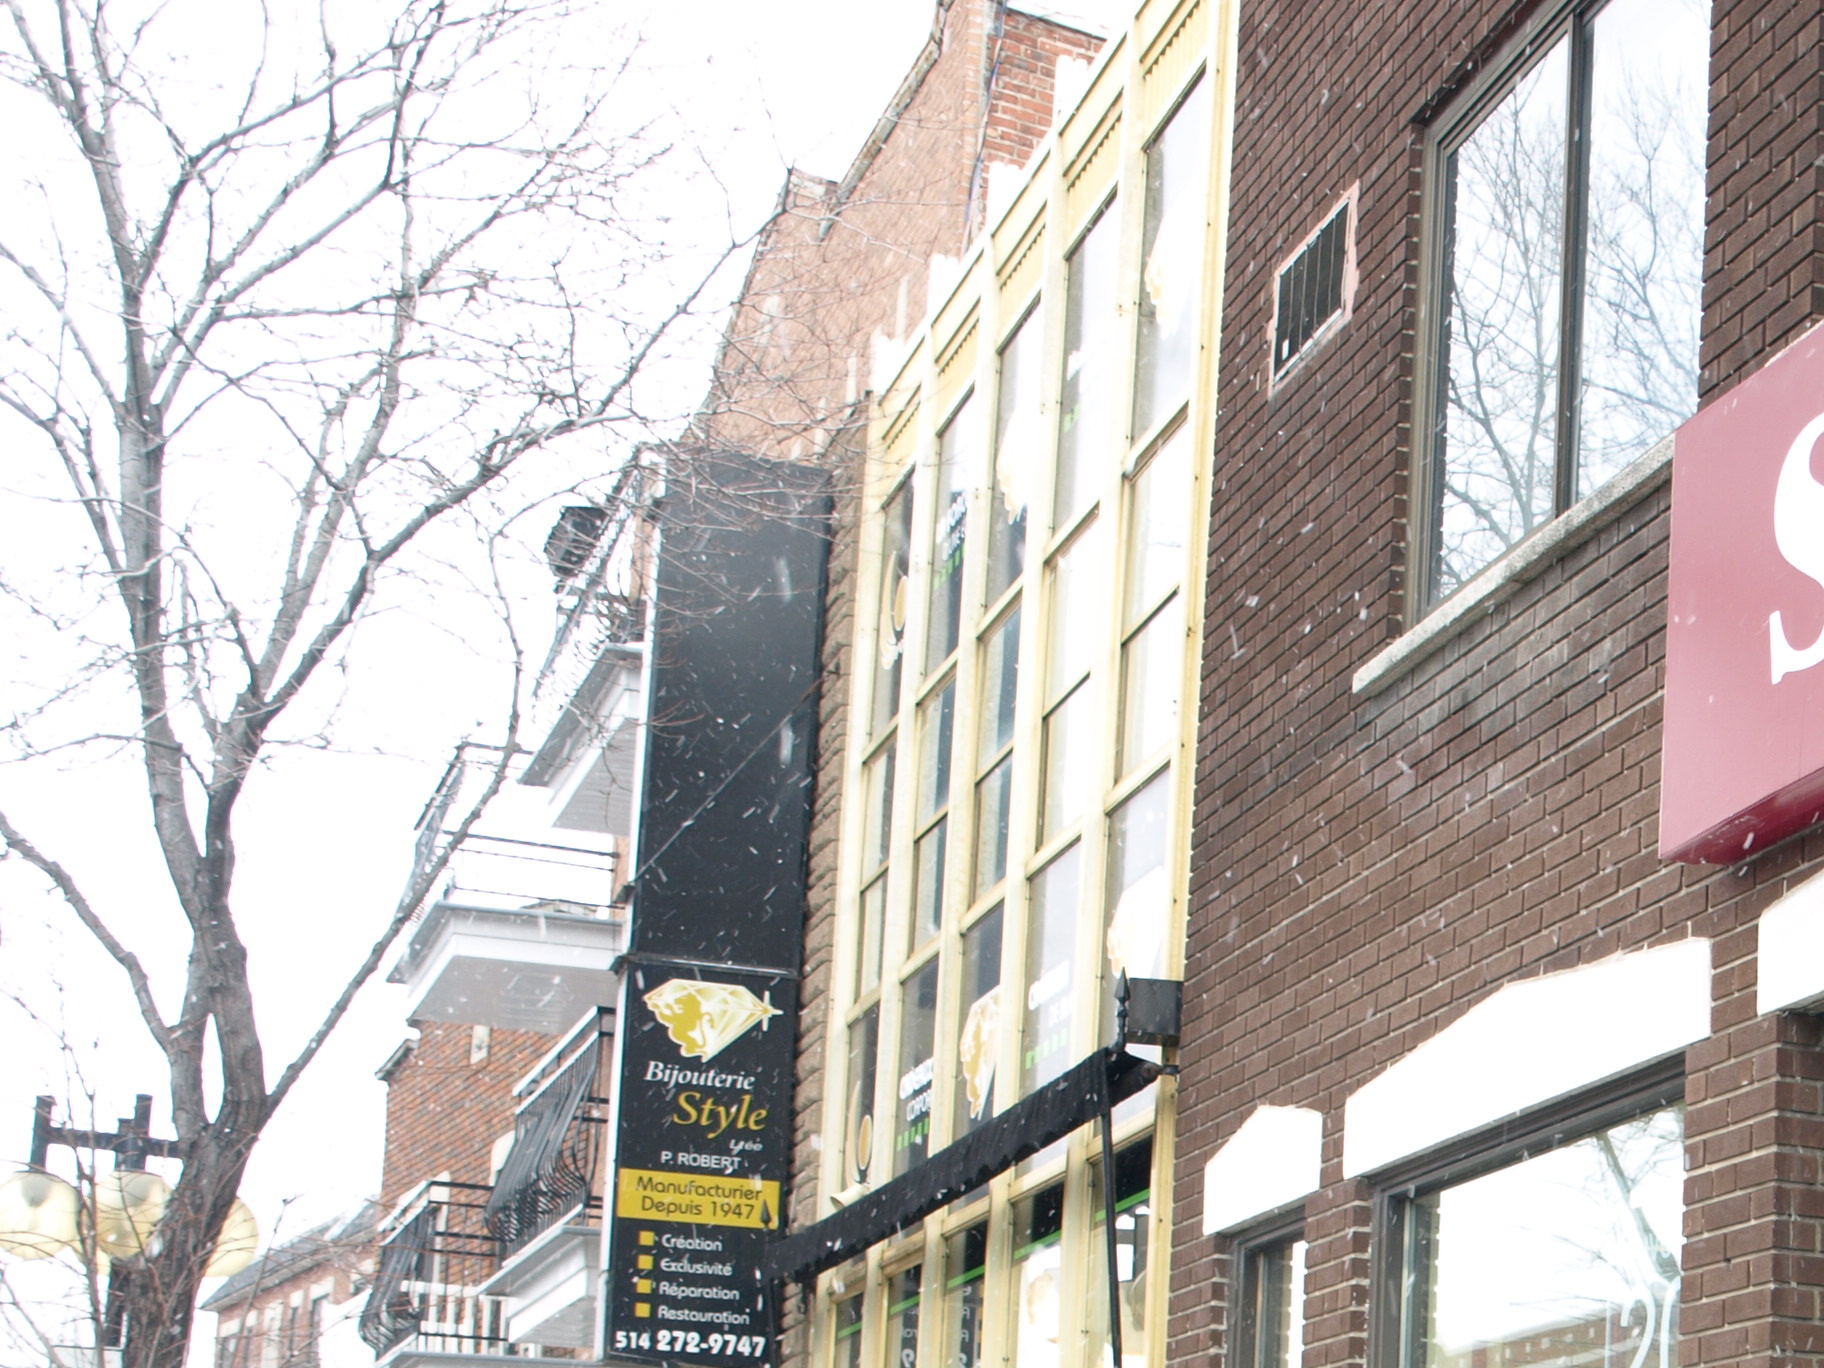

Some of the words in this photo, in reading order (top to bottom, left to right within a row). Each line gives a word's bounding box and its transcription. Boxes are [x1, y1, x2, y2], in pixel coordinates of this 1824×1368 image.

[644, 1060, 756, 1090] Bijouterie
[672, 1091, 768, 1139] Style
[660, 1150, 674, 1165] P.
[677, 1152, 741, 1170] ROBERT
[636, 1175, 763, 1201] Manufacturier
[641, 1195, 702, 1217] Depuis
[711, 1200, 755, 1220] 1947
[661, 1233, 723, 1252] Création
[659, 1257, 733, 1277] Exclusivité
[658, 1280, 740, 1301] Réparation
[657, 1304, 751, 1326] Restauration
[615, 1330, 651, 1350] 514
[656, 1329, 766, 1358] 272-9747
